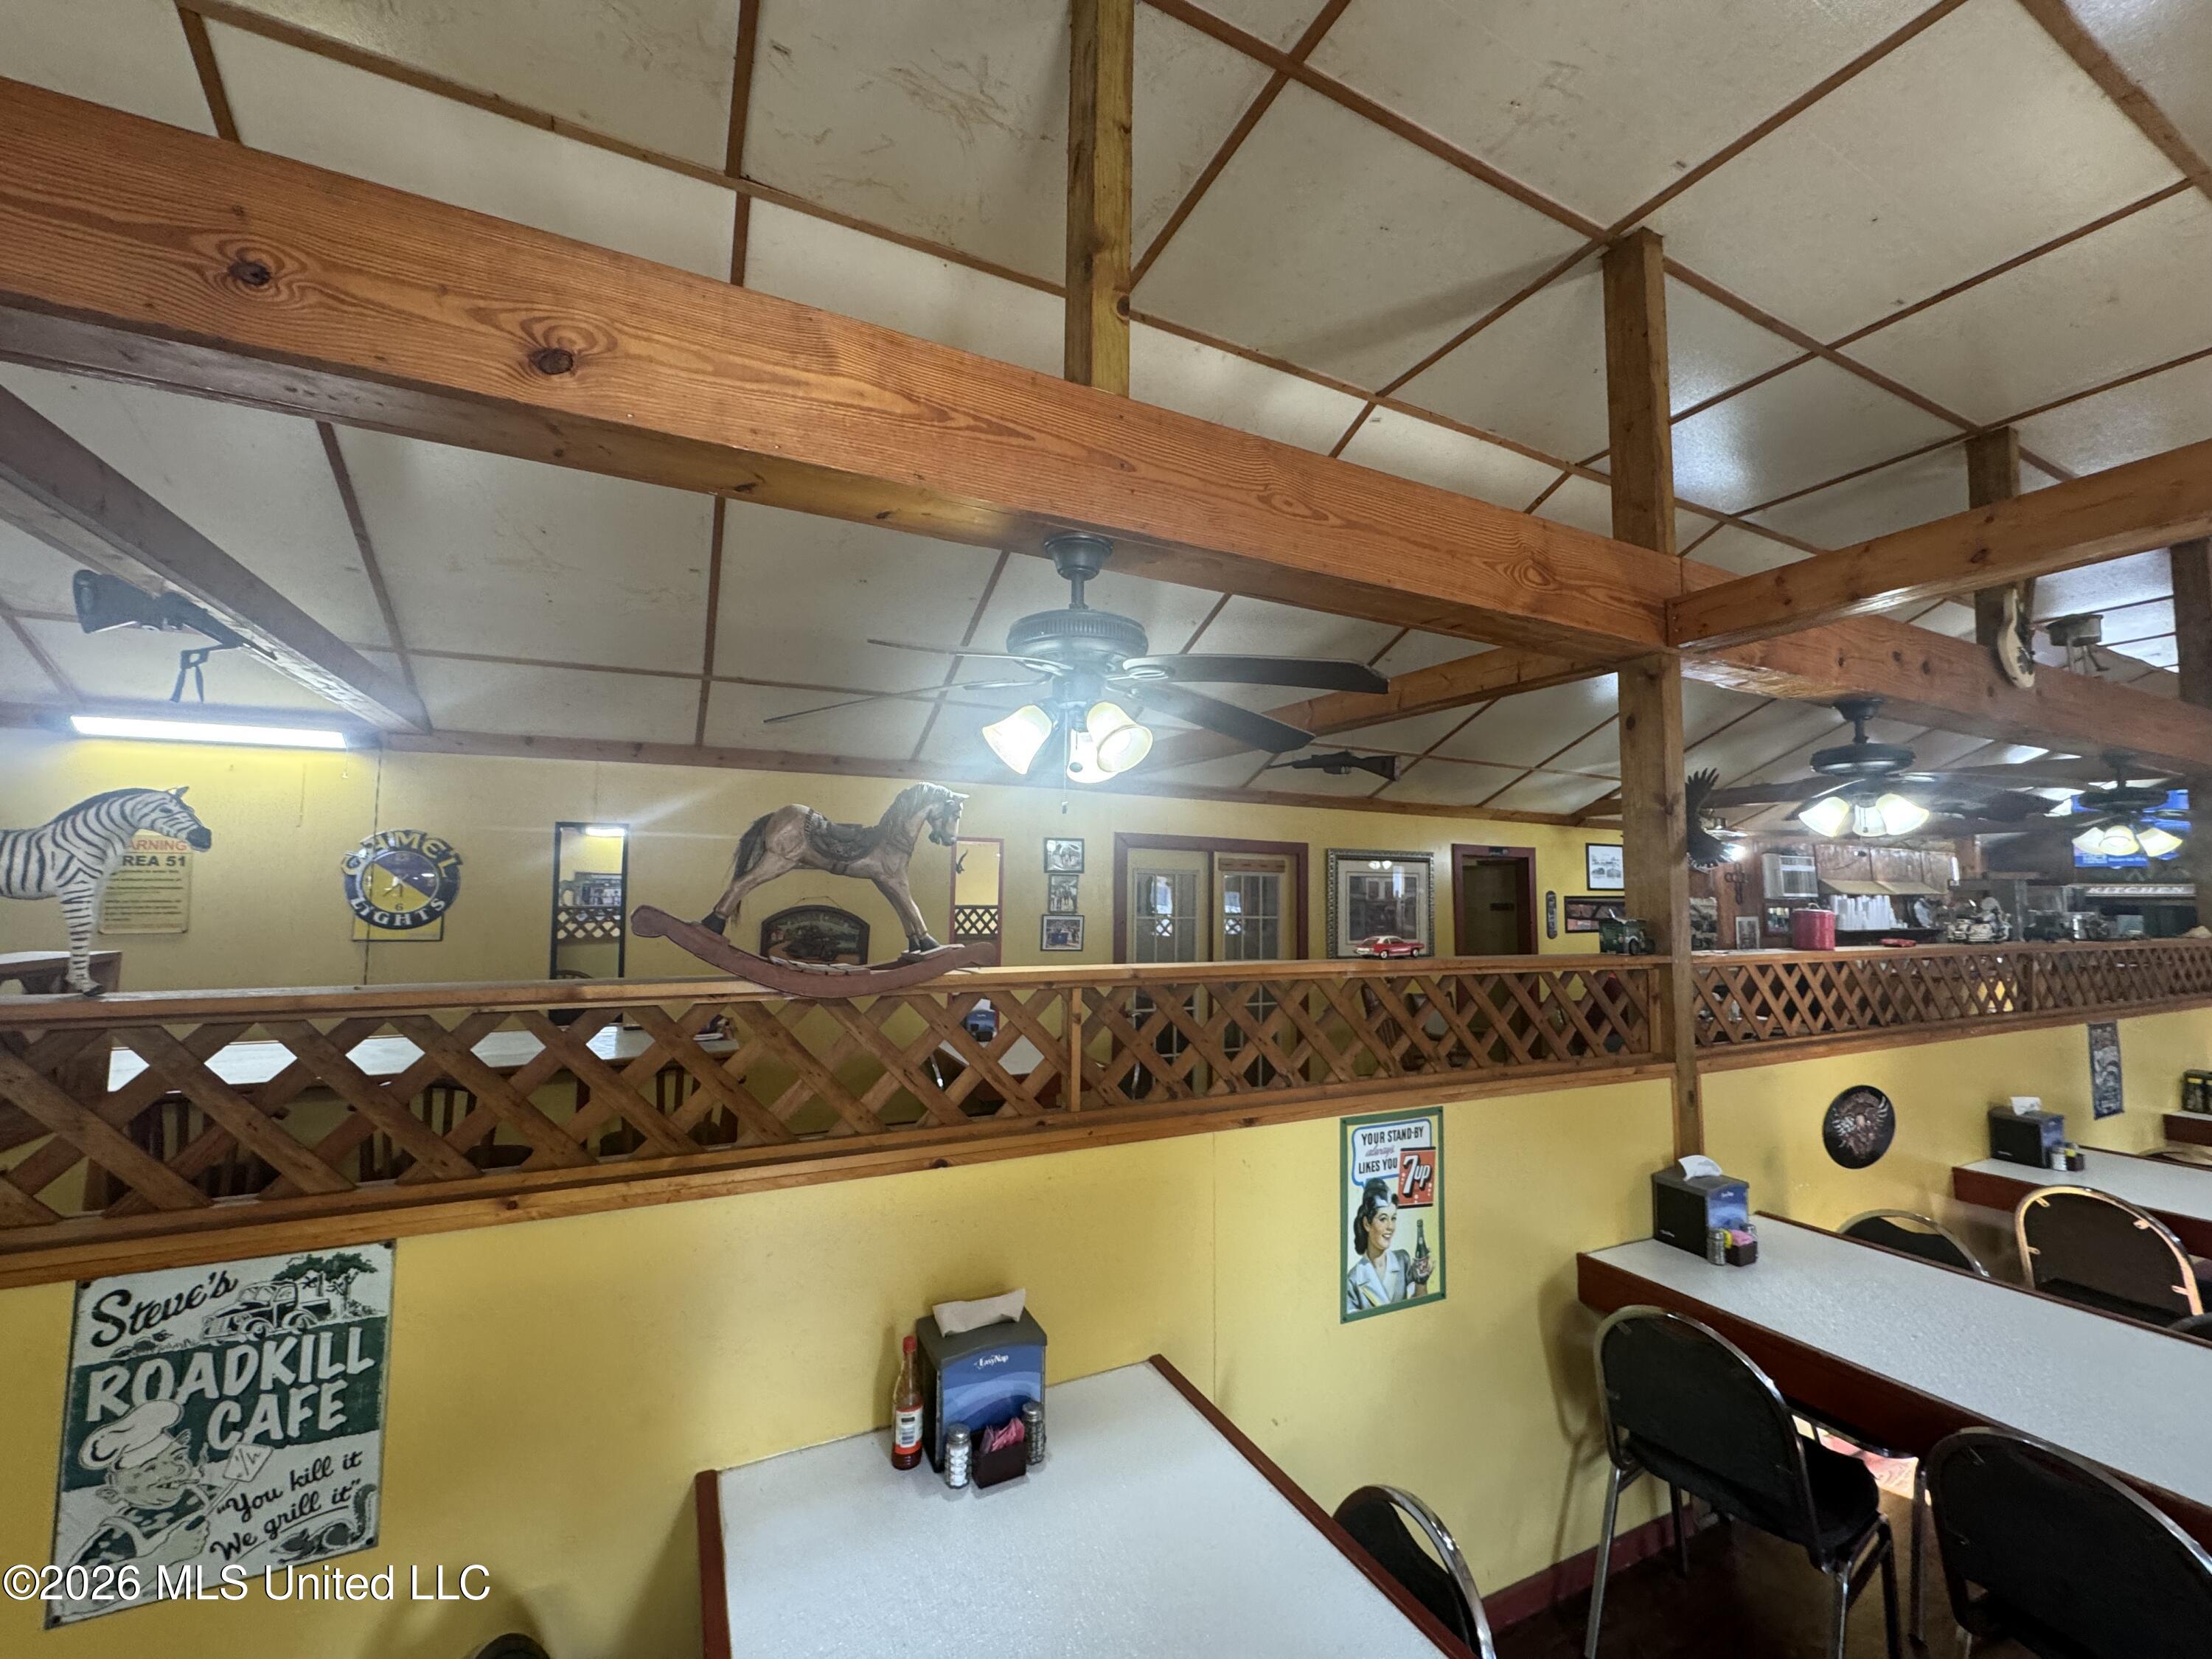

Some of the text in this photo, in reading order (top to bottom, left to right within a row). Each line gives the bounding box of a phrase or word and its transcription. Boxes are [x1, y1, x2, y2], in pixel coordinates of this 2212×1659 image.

[129, 838, 188, 851] ARNING
[341, 831, 458, 878] CAMEL
[122, 855, 187, 866] REA 51
[350, 897, 445, 927] LIGHTS
[1361, 1126, 1425, 1146] YOUR STAND-BY
[1358, 1157, 1398, 1175] LIKES YOU
[1365, 1144, 1395, 1159] always
[91, 1270, 238, 1348] Steve's
[86, 1326, 375, 1422] ROADKILL
[978, 1354, 1009, 1366] EasyNap
[206, 1379, 349, 1451] CAFE
[289, 1455, 334, 1492] kill
[342, 1450, 364, 1470] it
[209, 1531, 258, 1561] We
[263, 1490, 322, 1541] grill
